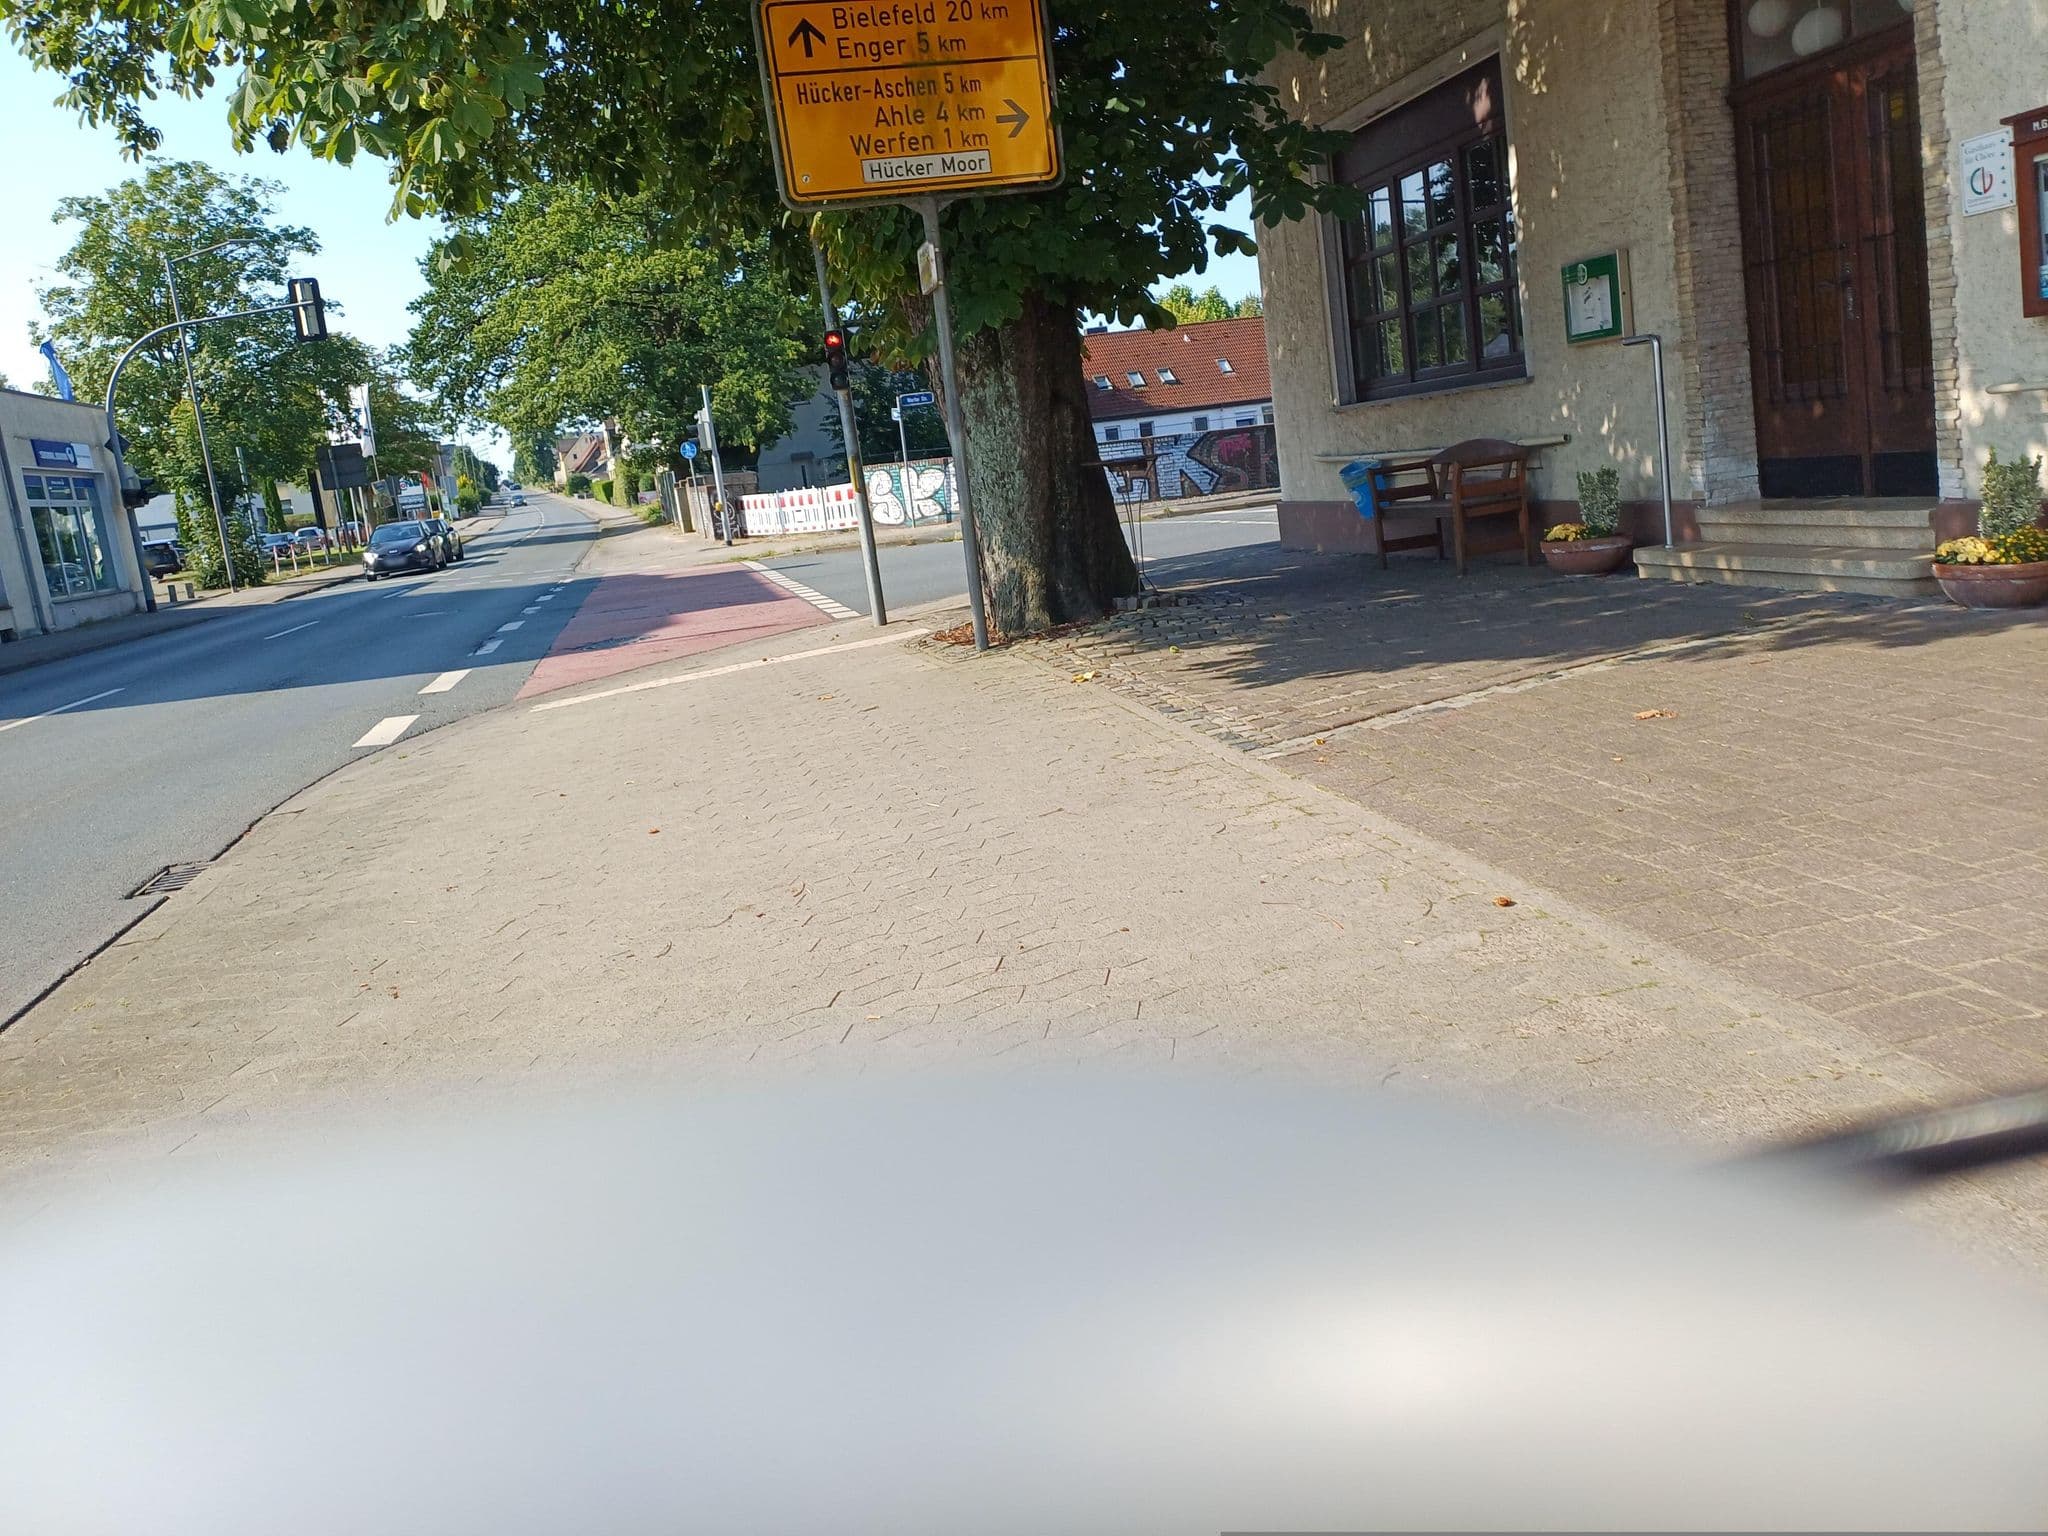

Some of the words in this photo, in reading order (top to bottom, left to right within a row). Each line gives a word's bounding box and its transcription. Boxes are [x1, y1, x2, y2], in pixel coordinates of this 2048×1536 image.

[832, 1, 936, 30] Bielefeld
[946, 0, 973, 22] 20
[980, 2, 1009, 21] km
[836, 36, 907, 63] Enger
[916, 31, 930, 54] 5
[938, 35, 967, 52] km
[796, 76, 937, 105] Hücker-Aschen
[943, 73, 954, 94] 5
[960, 76, 982, 93] km
[875, 103, 925, 128] Ahle
[936, 101, 949, 122] 4
[957, 104, 986, 121] km
[850, 131, 935, 156] Werfen
[944, 127, 952, 148] 1
[960, 130, 989, 147] km
[870, 155, 934, 180] Hücker
[941, 155, 986, 173] Moor
